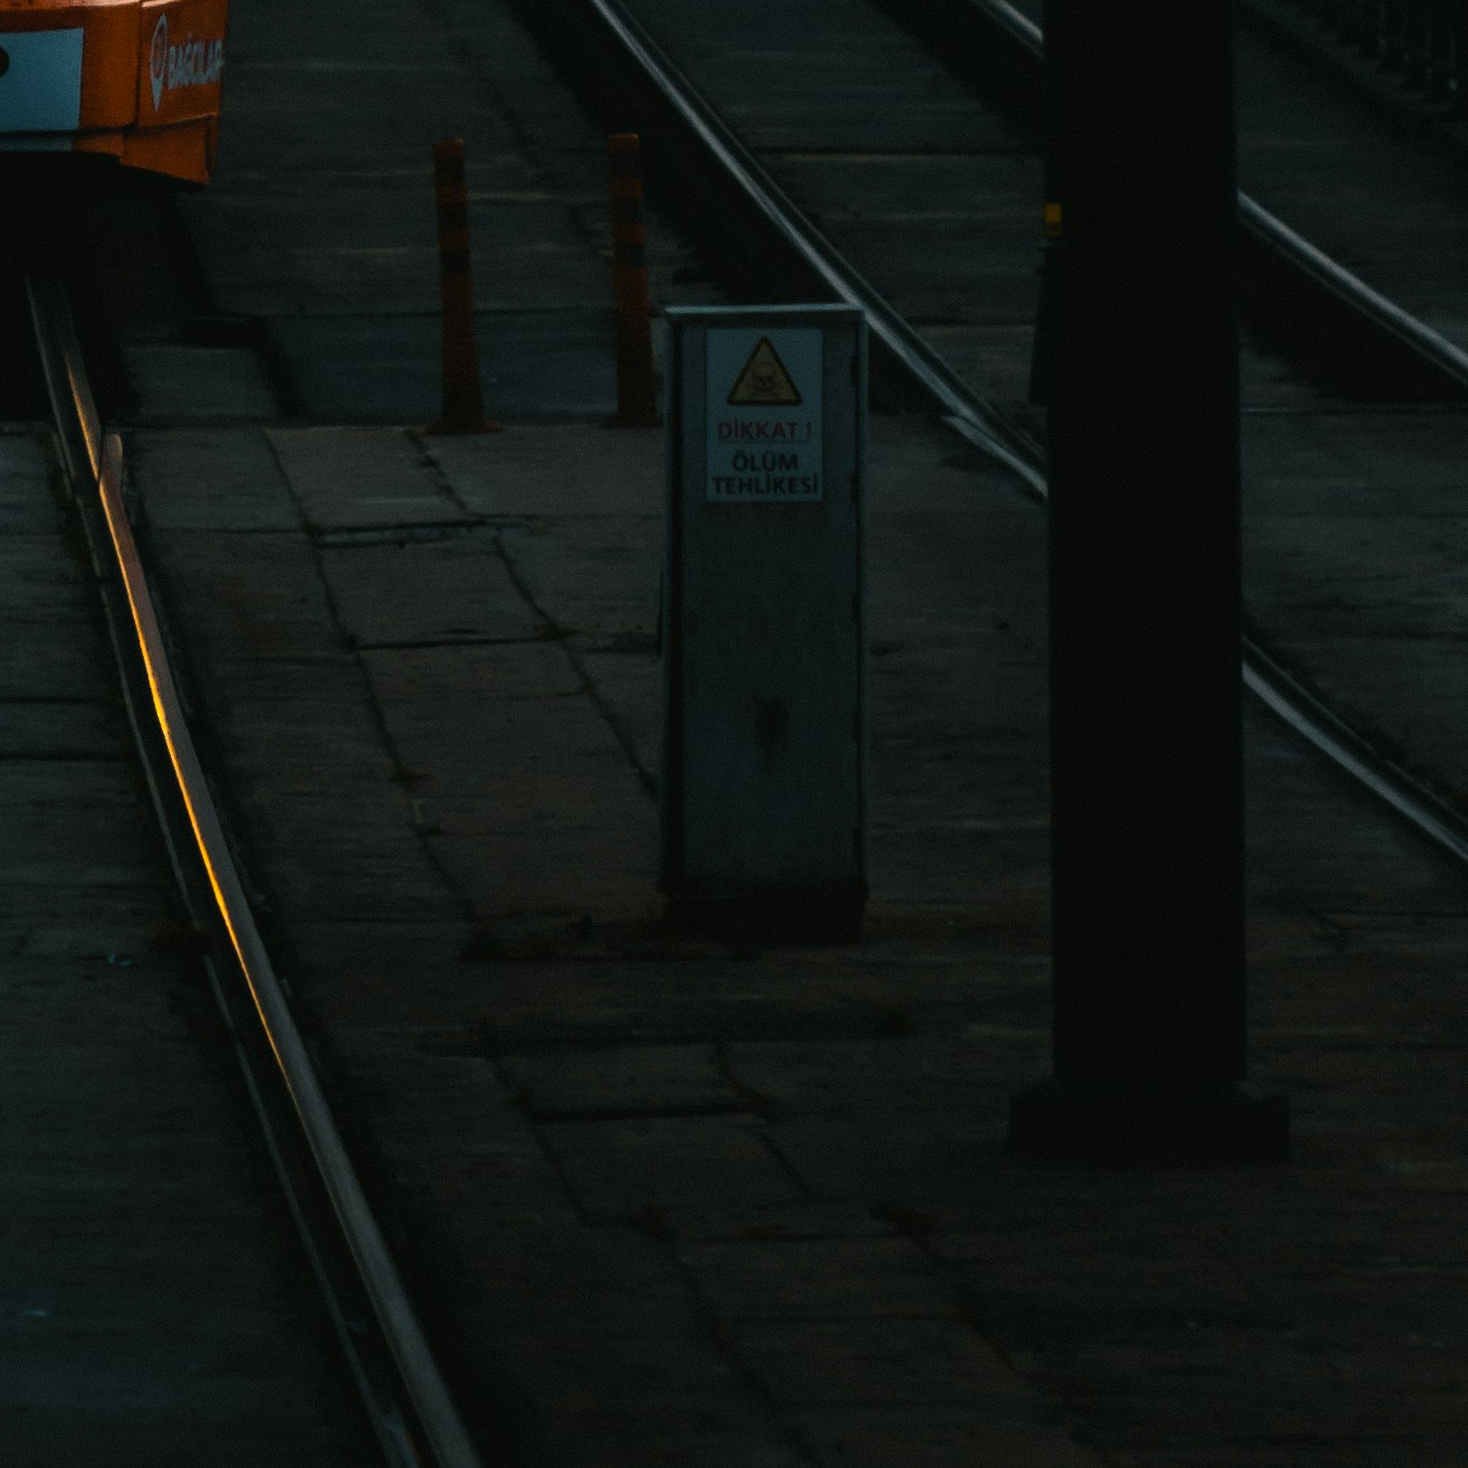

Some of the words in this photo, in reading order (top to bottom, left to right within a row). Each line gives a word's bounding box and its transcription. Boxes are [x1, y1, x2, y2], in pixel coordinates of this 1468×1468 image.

[717, 417, 798, 440] DİKKAT
[732, 449, 799, 472] ÖLÜM
[711, 473, 819, 495] TEHLİKESİ
